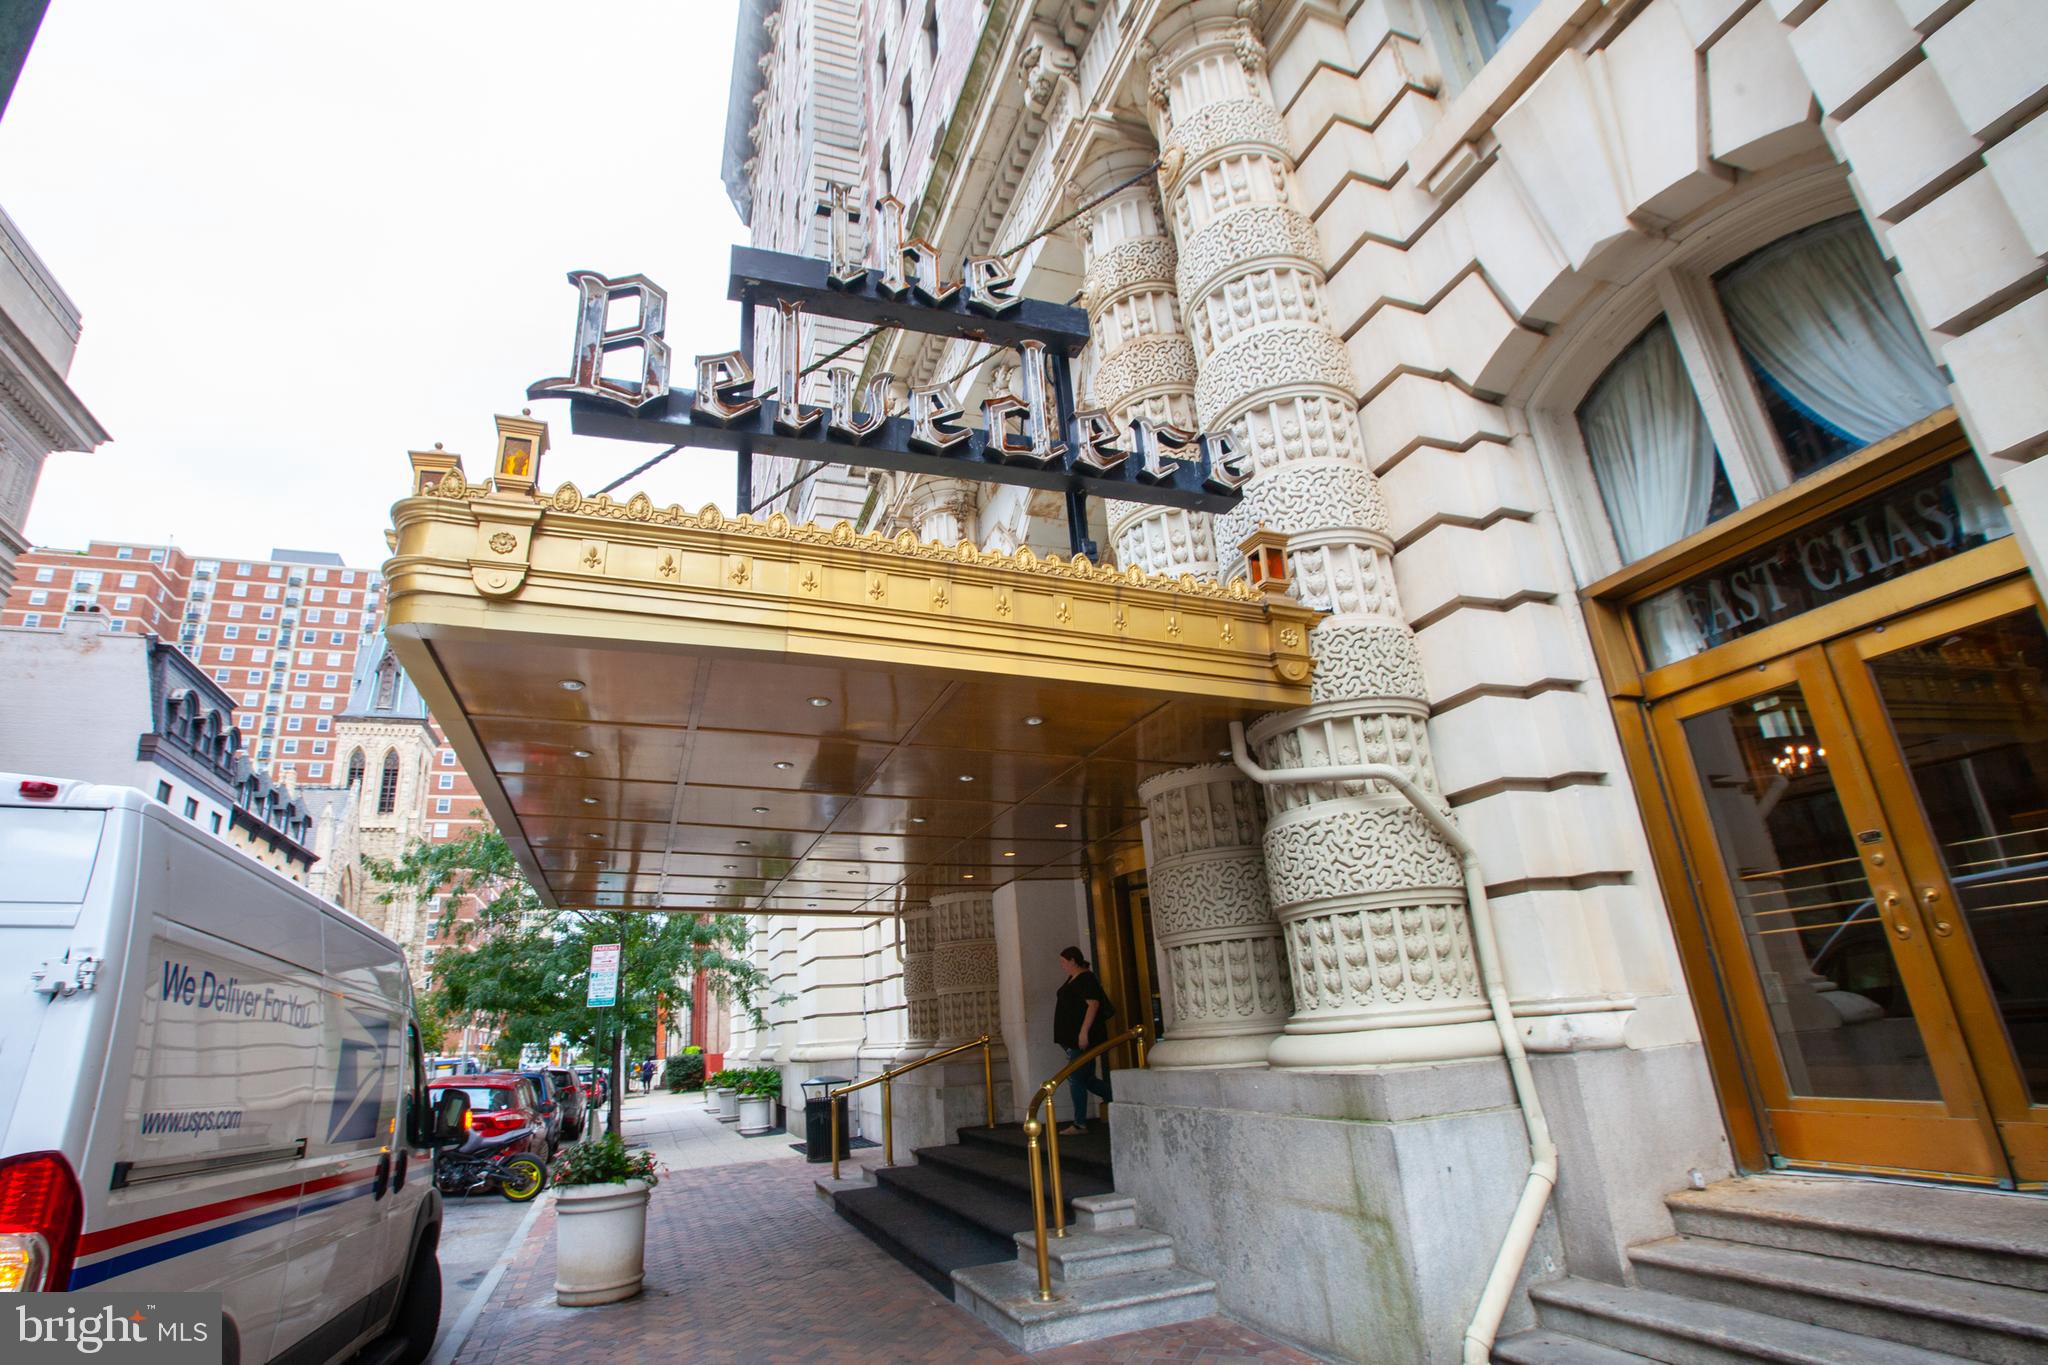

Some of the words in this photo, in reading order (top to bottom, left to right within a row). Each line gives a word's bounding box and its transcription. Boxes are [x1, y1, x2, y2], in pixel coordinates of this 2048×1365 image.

[526, 269, 1255, 496] Belvedere
[1684, 556, 1788, 643] EAST
[1800, 486, 1958, 593] CHAS
[163, 960, 197, 1006] We
[198, 970, 262, 1018] Deliver
[262, 988, 289, 1022] For
[142, 1109, 242, 1138] www.usps.com
